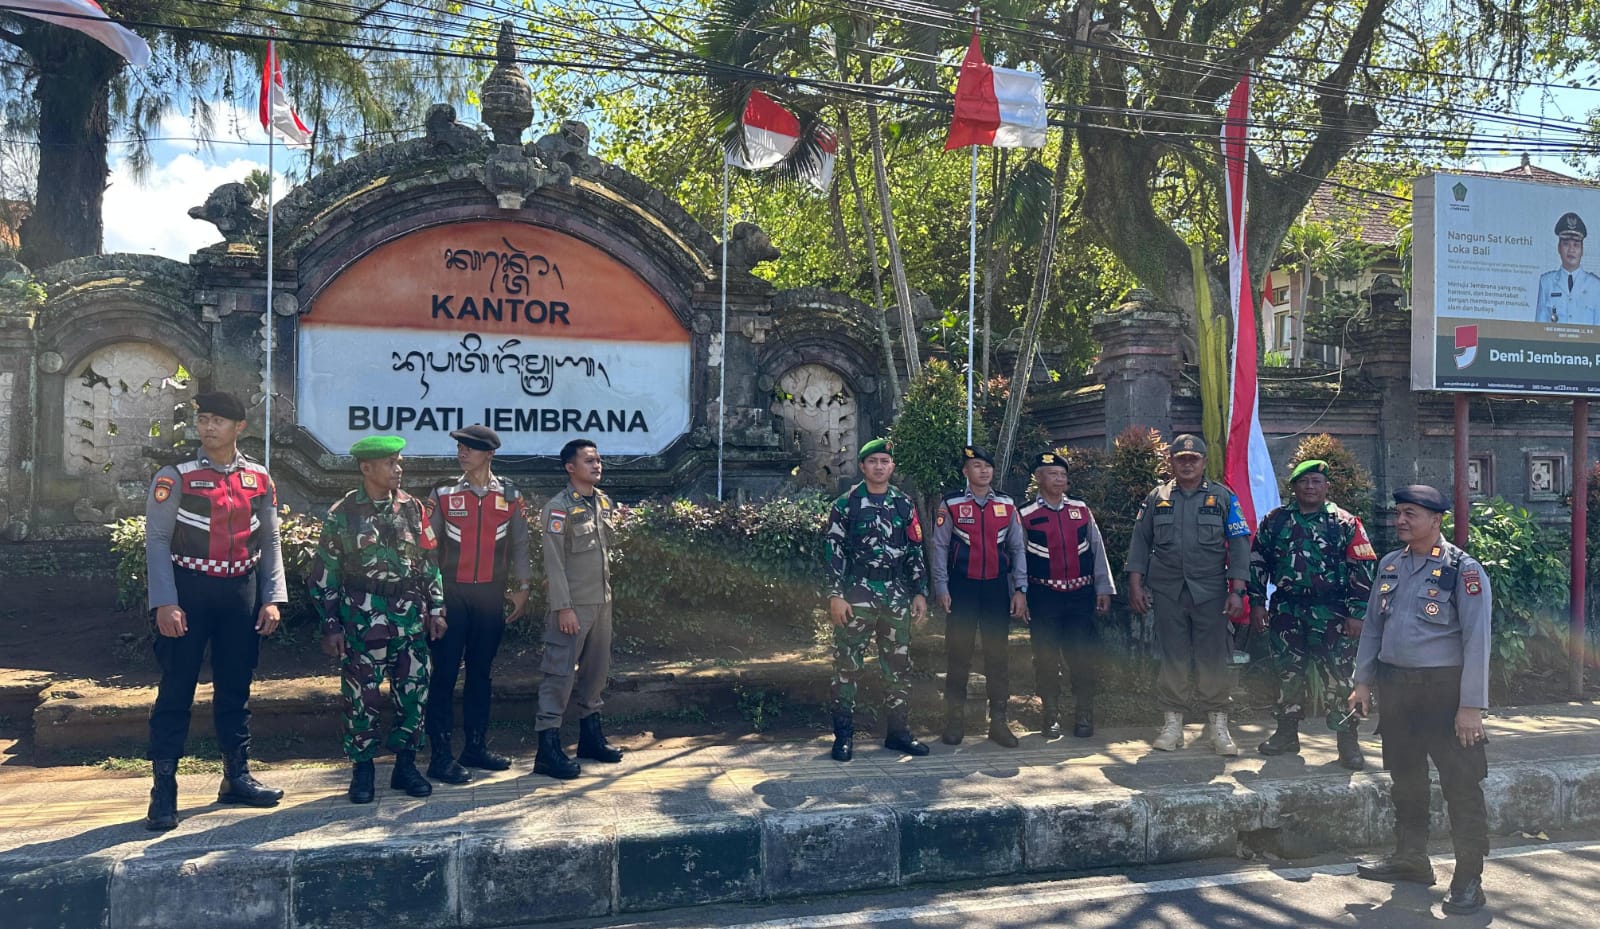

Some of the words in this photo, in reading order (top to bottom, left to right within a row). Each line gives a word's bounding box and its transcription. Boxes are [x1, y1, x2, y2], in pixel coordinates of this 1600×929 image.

[1447, 230, 1485, 243] Nangun
[1487, 233, 1502, 243] Sat
[1504, 234, 1533, 246] Kerthi
[1447, 244, 1470, 254] Loka
[1472, 246, 1490, 256] Bali
[432, 294, 570, 325] KANTOR
[1489, 349, 1525, 363] Demi
[1526, 351, 1593, 368] Jembrana,
[348, 405, 464, 431] BUPATI
[474, 407, 649, 433] JEMBRANA
